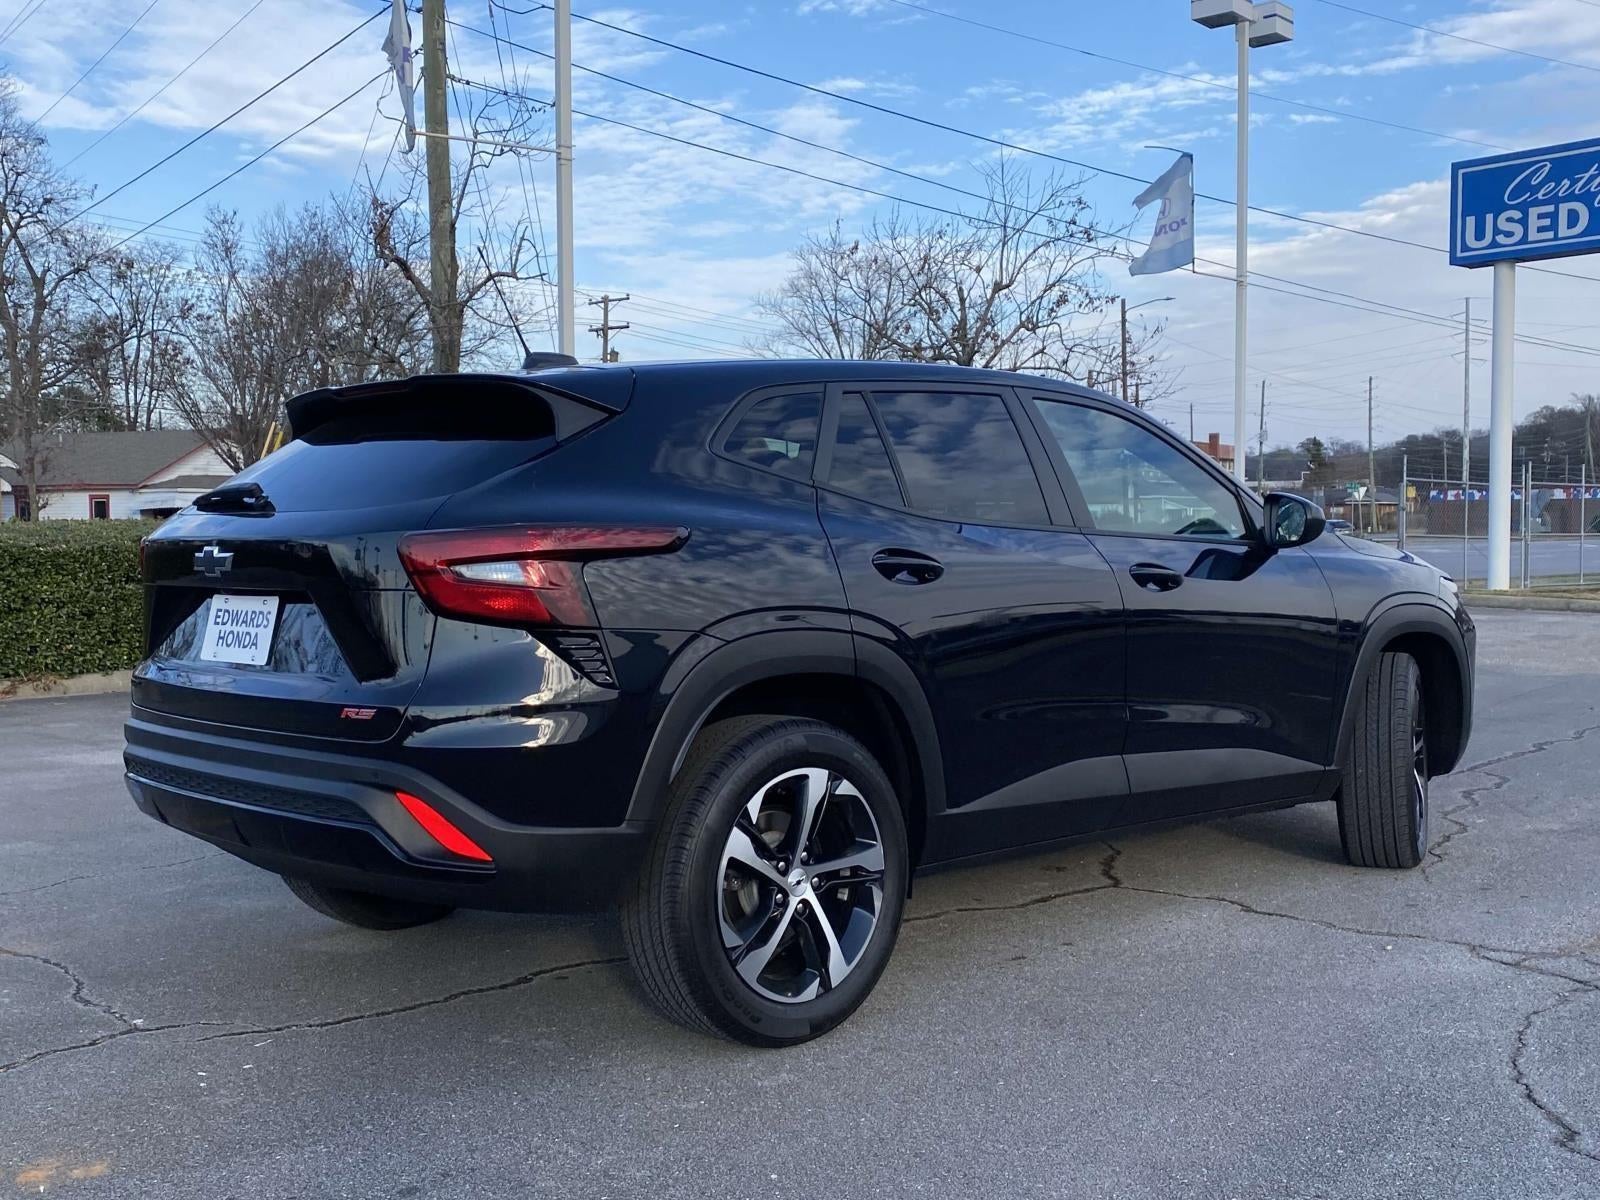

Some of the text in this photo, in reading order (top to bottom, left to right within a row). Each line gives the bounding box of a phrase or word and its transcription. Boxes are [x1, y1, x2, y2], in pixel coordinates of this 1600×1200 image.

[1465, 201, 1590, 249] USED
[213, 608, 272, 629] EDWARDS
[216, 630, 259, 650] HONDA
[340, 707, 377, 720] RS
